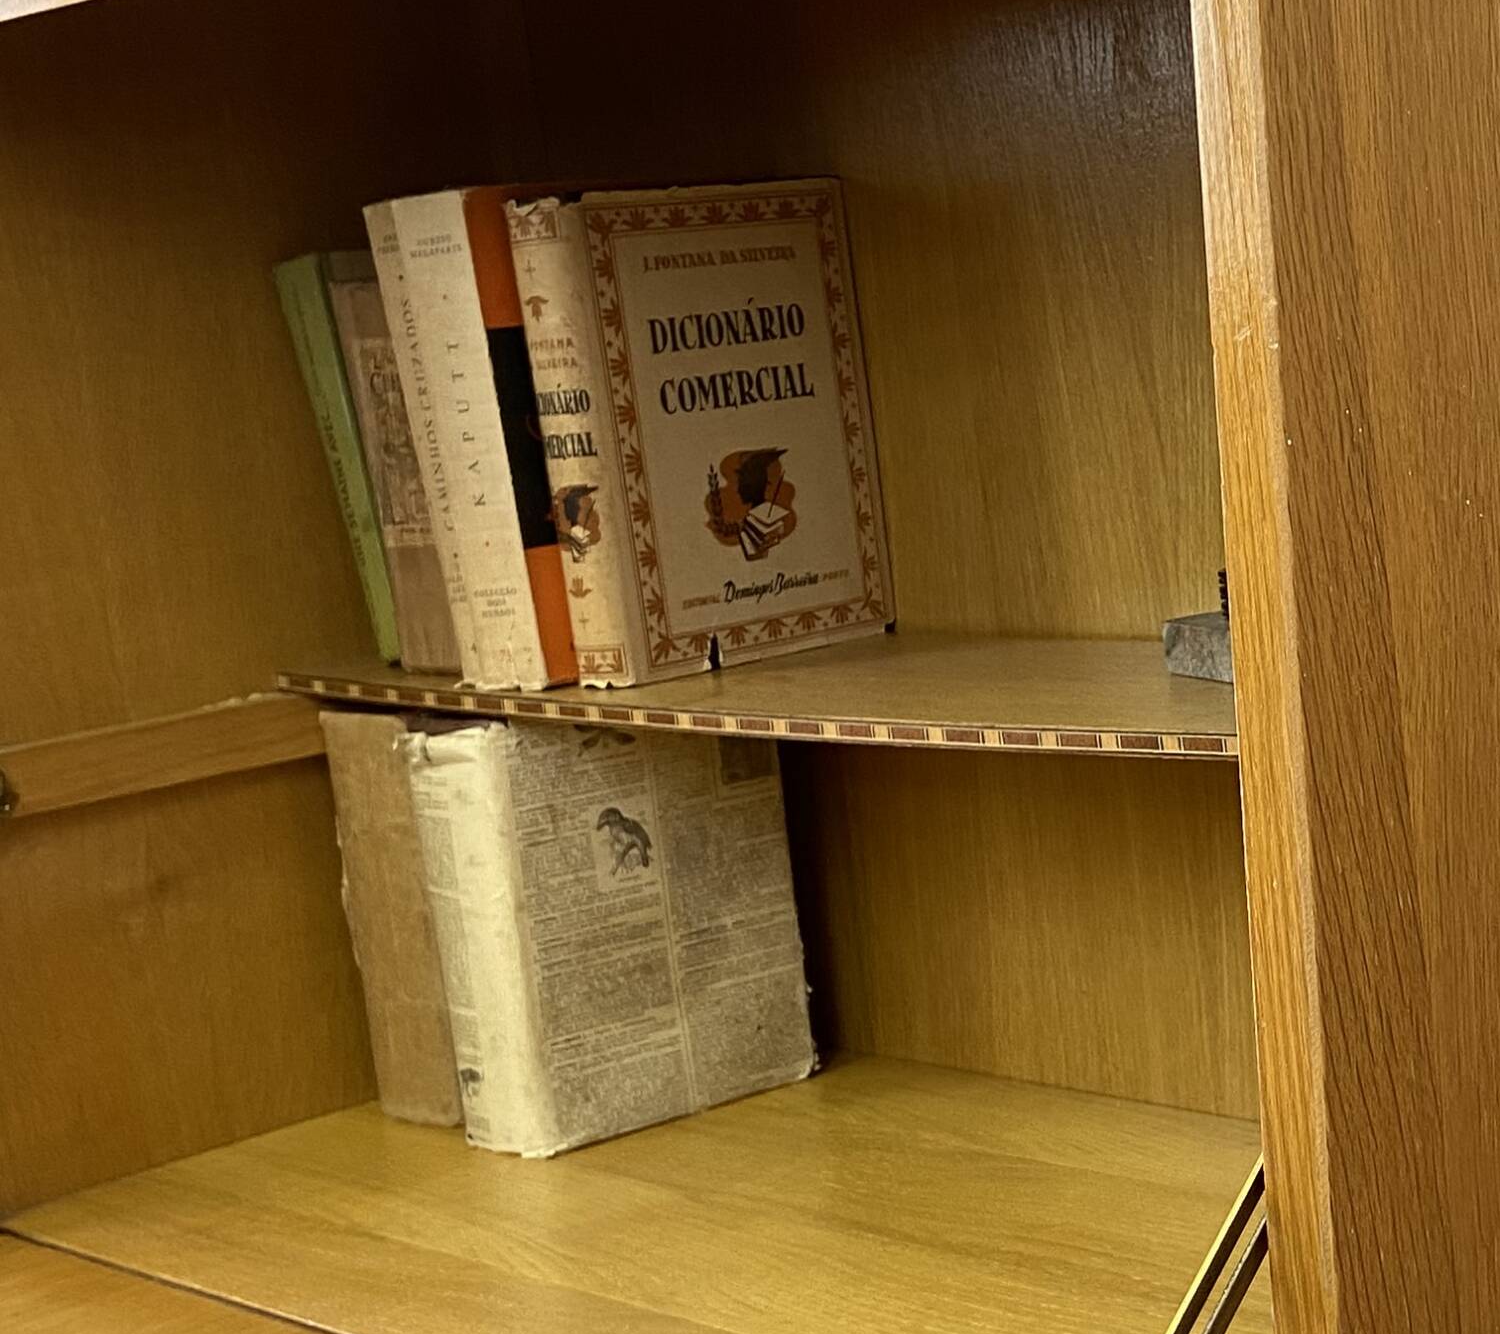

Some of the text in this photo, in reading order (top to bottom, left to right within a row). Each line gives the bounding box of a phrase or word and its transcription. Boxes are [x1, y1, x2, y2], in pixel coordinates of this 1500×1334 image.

[655, 250, 716, 271] FONTANA
[647, 297, 805, 355] DICIONÁRIO
[401, 298, 455, 532] CAMINHOS CRUZADOS
[660, 363, 815, 415] COMERCIAL
[447, 341, 486, 507] KAPUTT
[724, 579, 774, 605] Domingos
